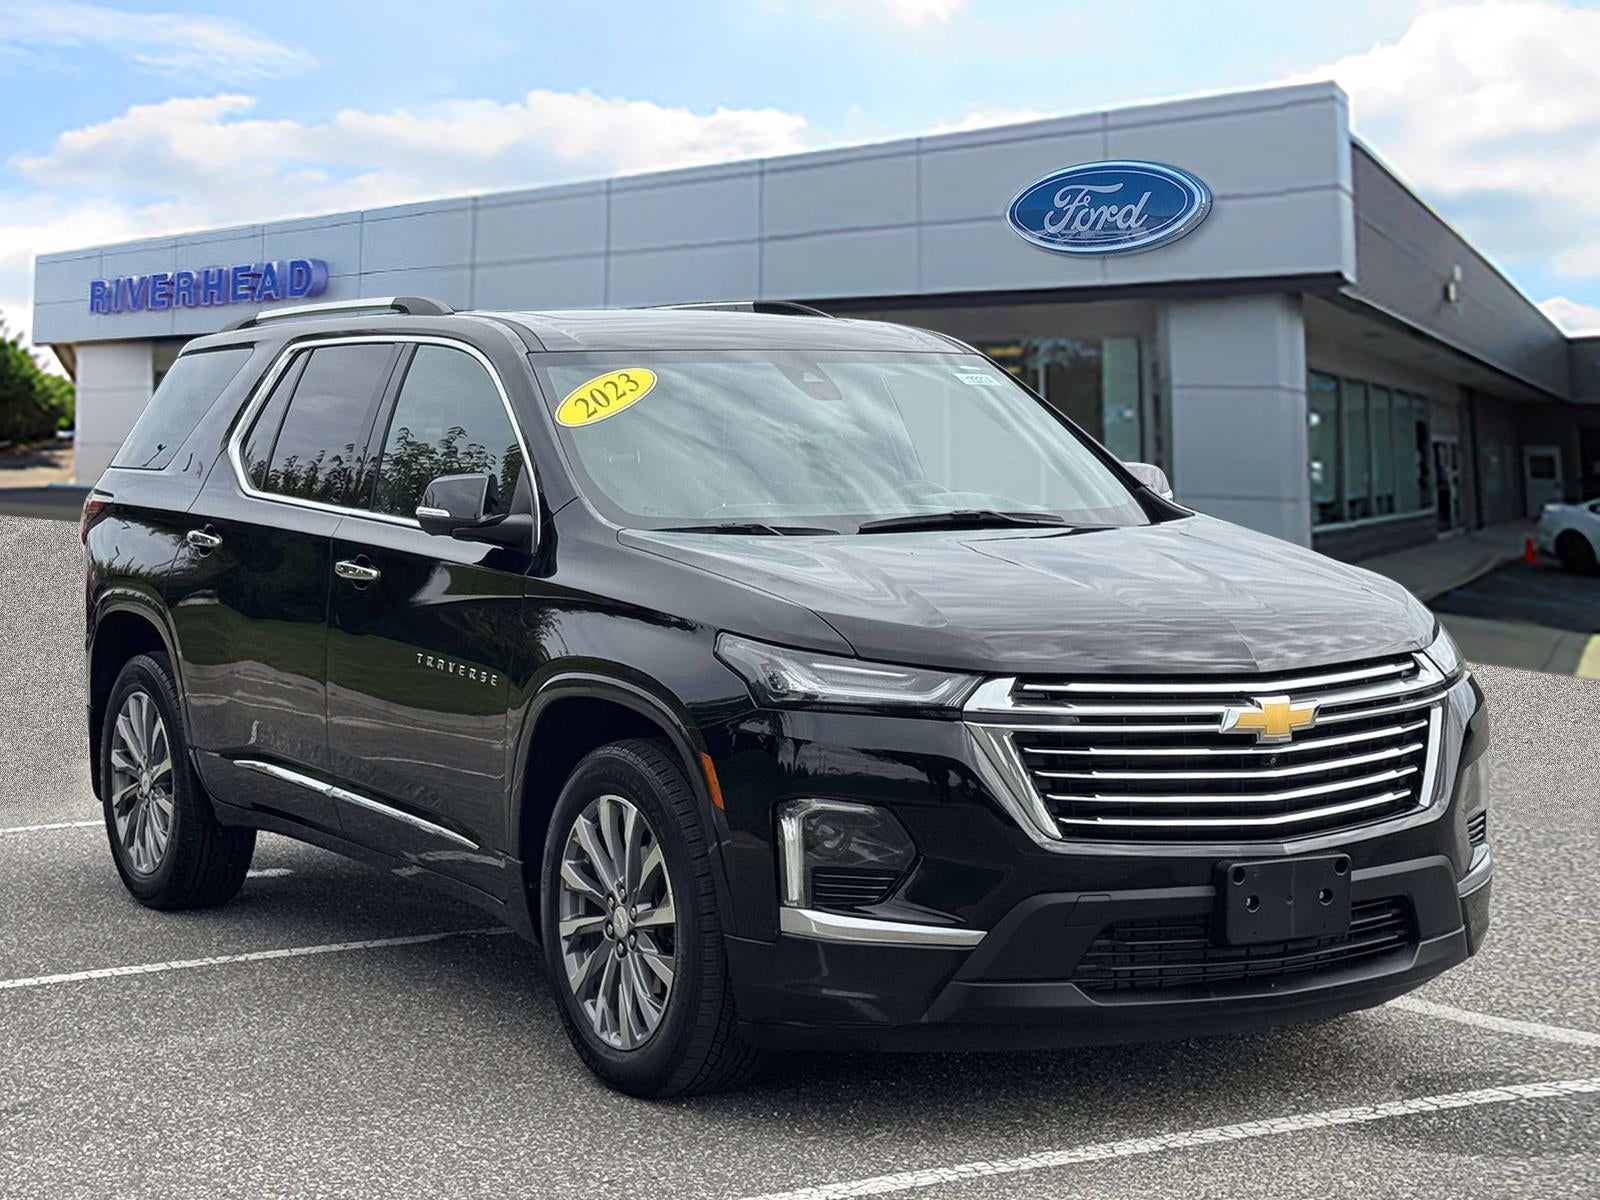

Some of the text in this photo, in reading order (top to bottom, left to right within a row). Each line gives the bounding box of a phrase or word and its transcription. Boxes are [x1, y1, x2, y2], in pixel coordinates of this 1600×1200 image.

[1044, 183, 1152, 233] Ford
[89, 259, 327, 315] RIVERHEAD
[574, 373, 639, 418] 2023
[416, 652, 498, 687] TRAVERSE
